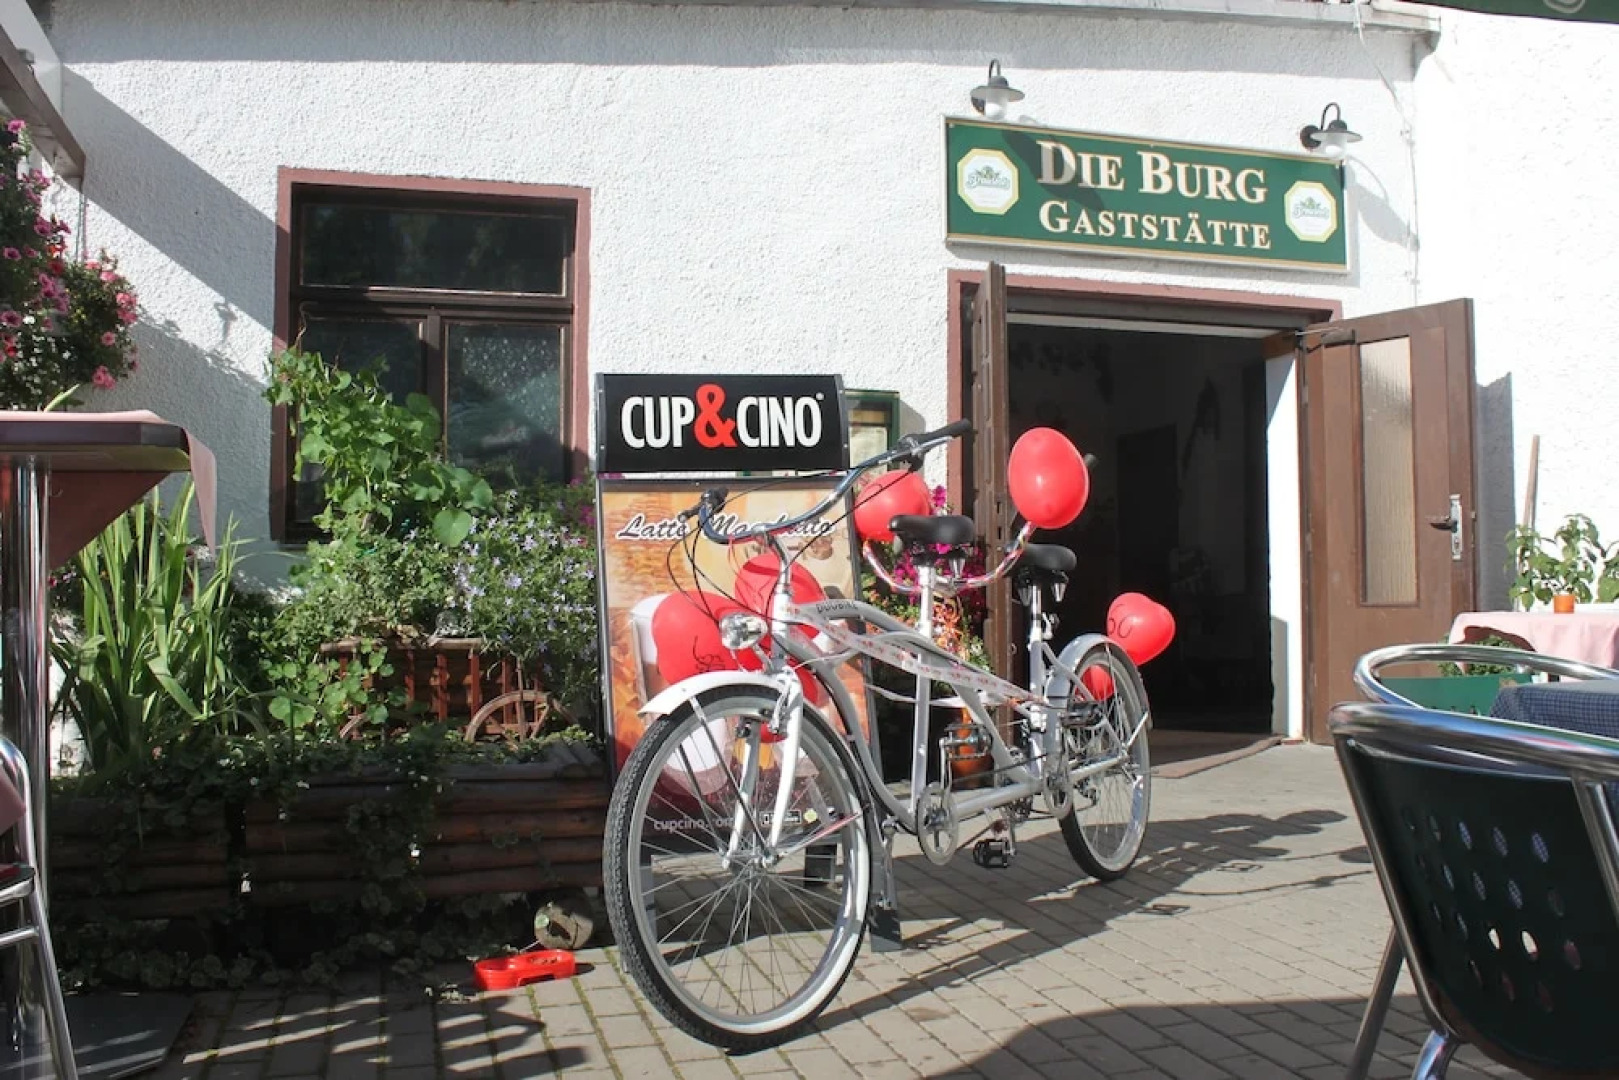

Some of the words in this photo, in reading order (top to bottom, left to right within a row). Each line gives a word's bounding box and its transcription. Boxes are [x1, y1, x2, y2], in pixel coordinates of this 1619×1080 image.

[1036, 140, 1125, 191] DIE
[1137, 151, 1267, 203] BURG
[1039, 200, 1271, 249] GASTSTÄTTE
[617, 513, 687, 539] Latte
